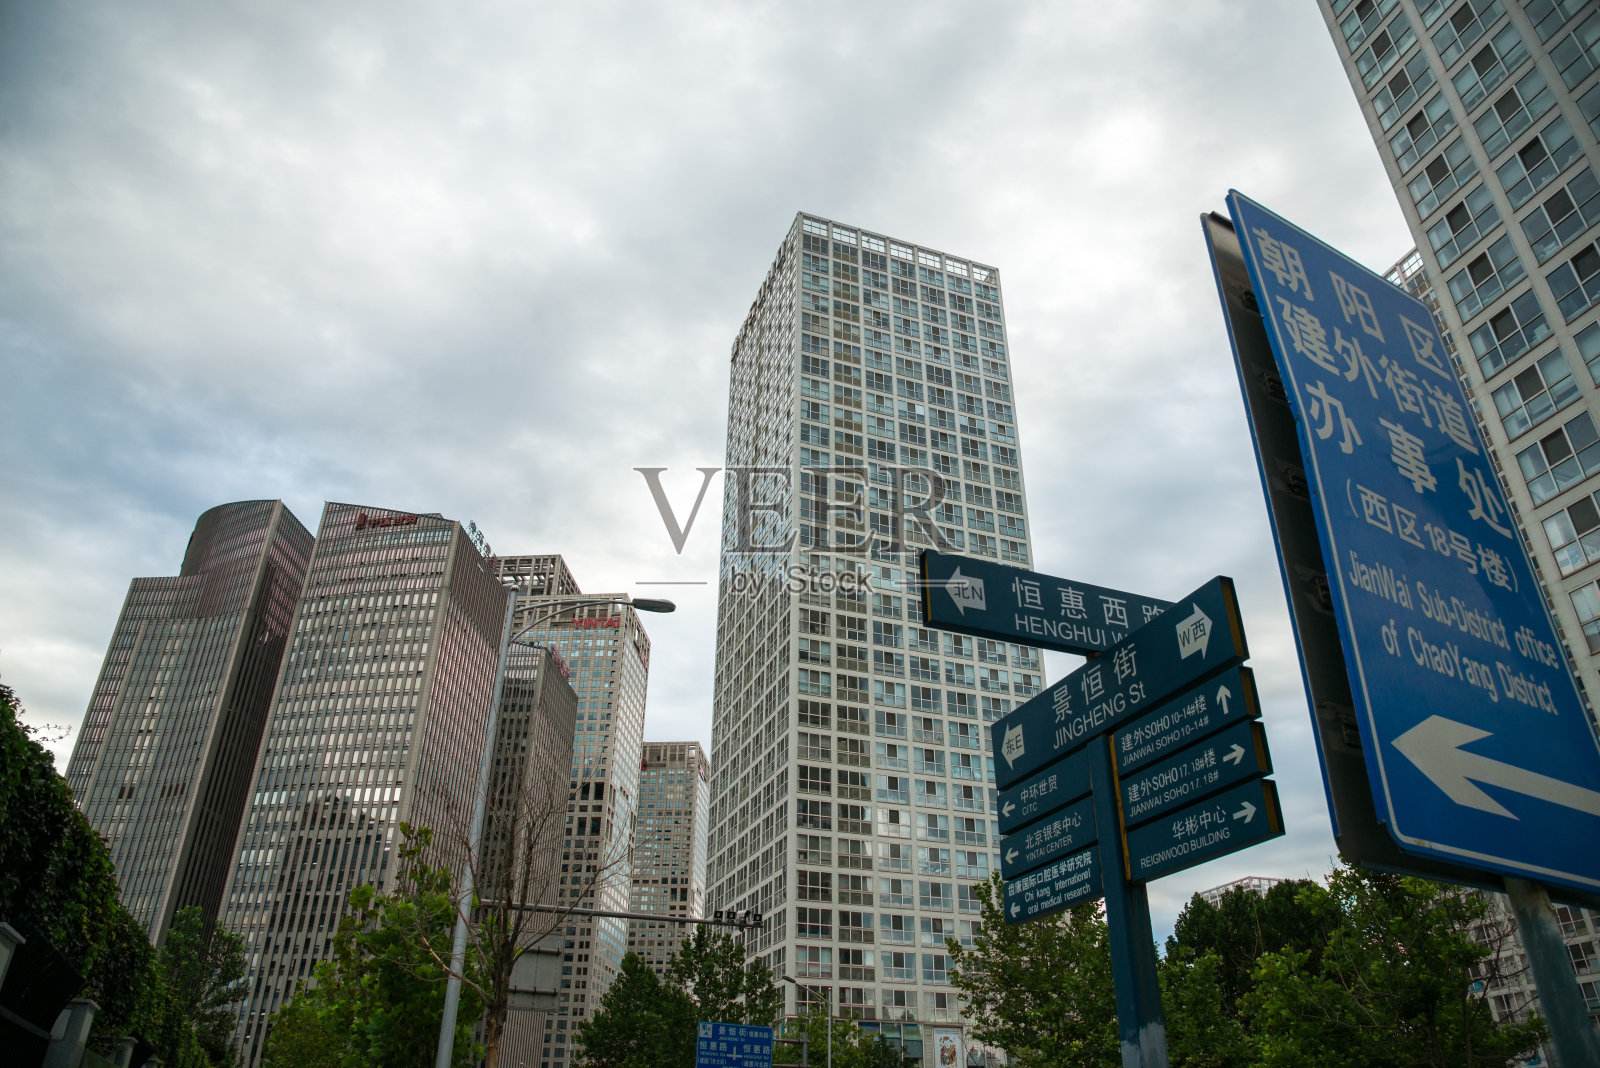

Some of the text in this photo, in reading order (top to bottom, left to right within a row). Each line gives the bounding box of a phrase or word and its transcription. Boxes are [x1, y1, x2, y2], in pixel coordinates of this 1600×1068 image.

[1252, 226, 1451, 381] 朝阳区
[1276, 295, 1479, 456] 建外街道
[1304, 380, 1513, 539] 办事处
[1346, 478, 1519, 593] (西区18号楼)
[572, 617, 621, 629] YINTAI
[1349, 550, 1559, 669] JianWai Sub-District office
[1015, 613, 1107, 646] HENGHUI
[1052, 642, 1137, 723] 景恒街
[1381, 618, 1401, 658] of
[1495, 661, 1559, 715] District
[1053, 681, 1146, 750] JINGHENG St
[1122, 743, 1155, 767] JIANWAI
[1020, 774, 1058, 803] 中环世贸
[1129, 795, 1162, 818] JIANWAI
[1021, 802, 1038, 816] CITC
[1172, 805, 1226, 840] 华彬中心
[1025, 812, 1082, 850] 北京银泰中心
[1025, 834, 1073, 862] YINTAI CENTER
[1140, 827, 1230, 869] REIGNWOOD BUILDING
[1007, 851, 1092, 897] 齿康国际口腔医学研究院
[1024, 868, 1091, 903] Chi kang International
[1027, 883, 1091, 915] oral medical research
